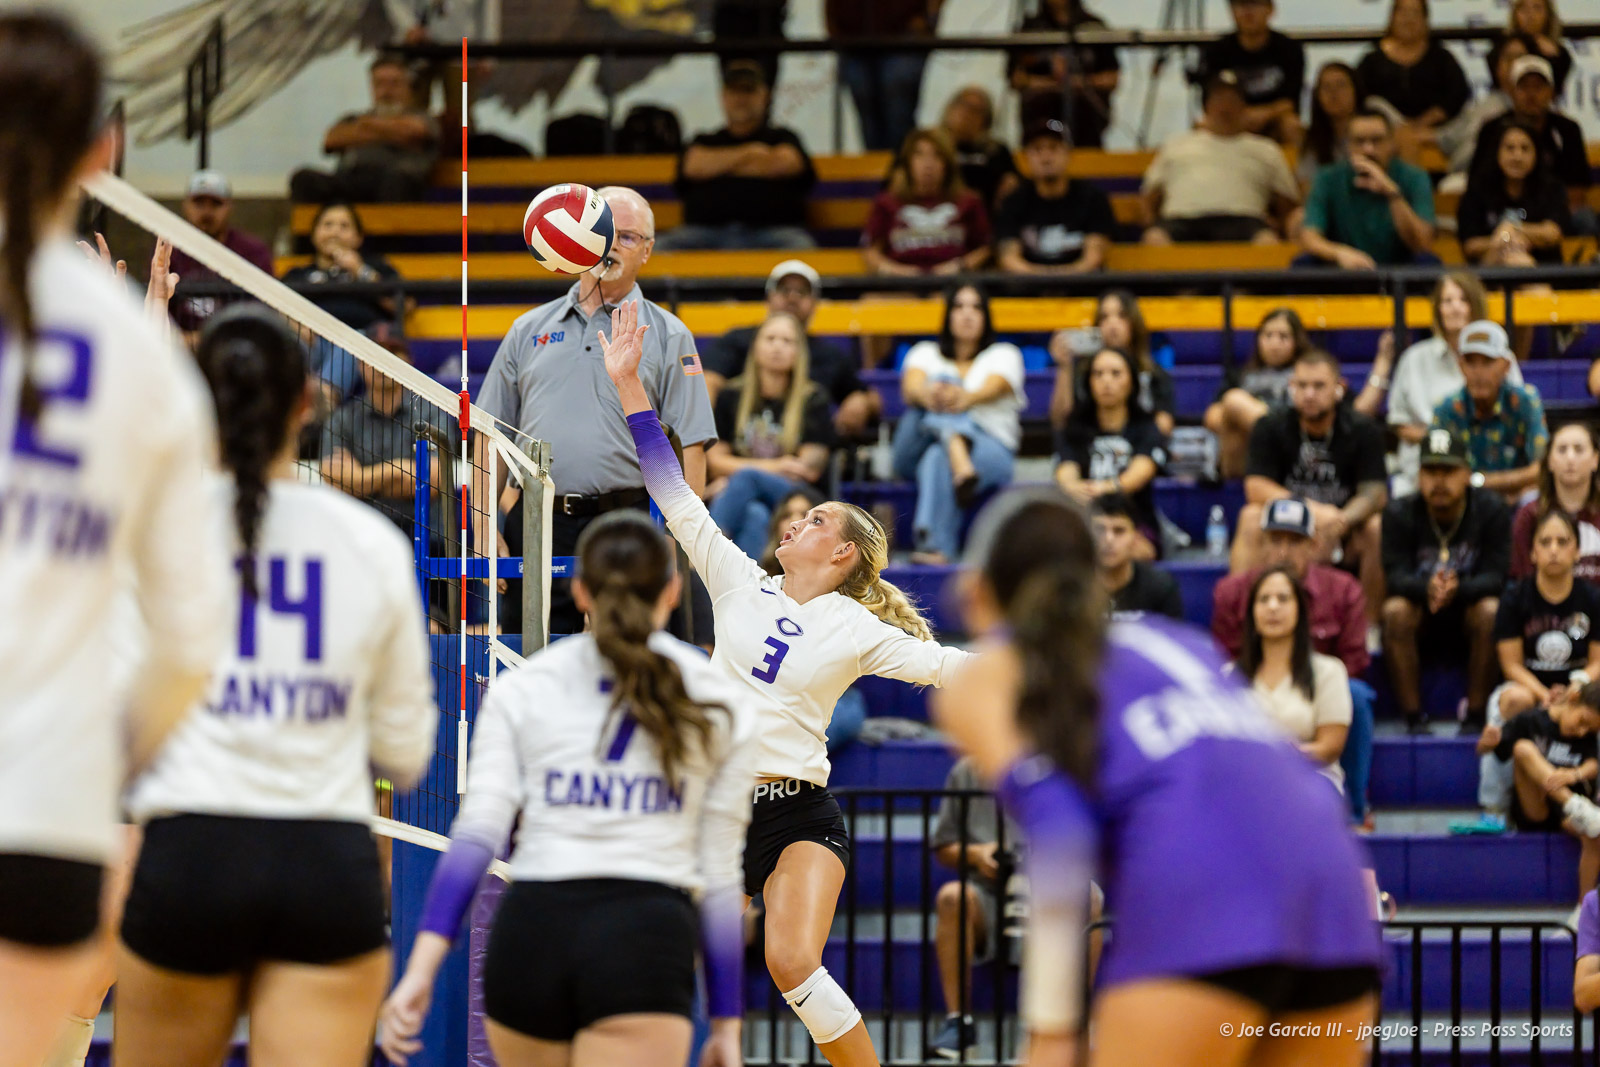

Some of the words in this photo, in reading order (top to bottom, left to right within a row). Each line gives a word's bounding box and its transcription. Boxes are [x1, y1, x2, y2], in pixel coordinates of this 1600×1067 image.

[233, 556, 322, 660] 14
[751, 635, 790, 684] 3
[544, 768, 686, 813] CANYON
[753, 778, 801, 804] PRO
